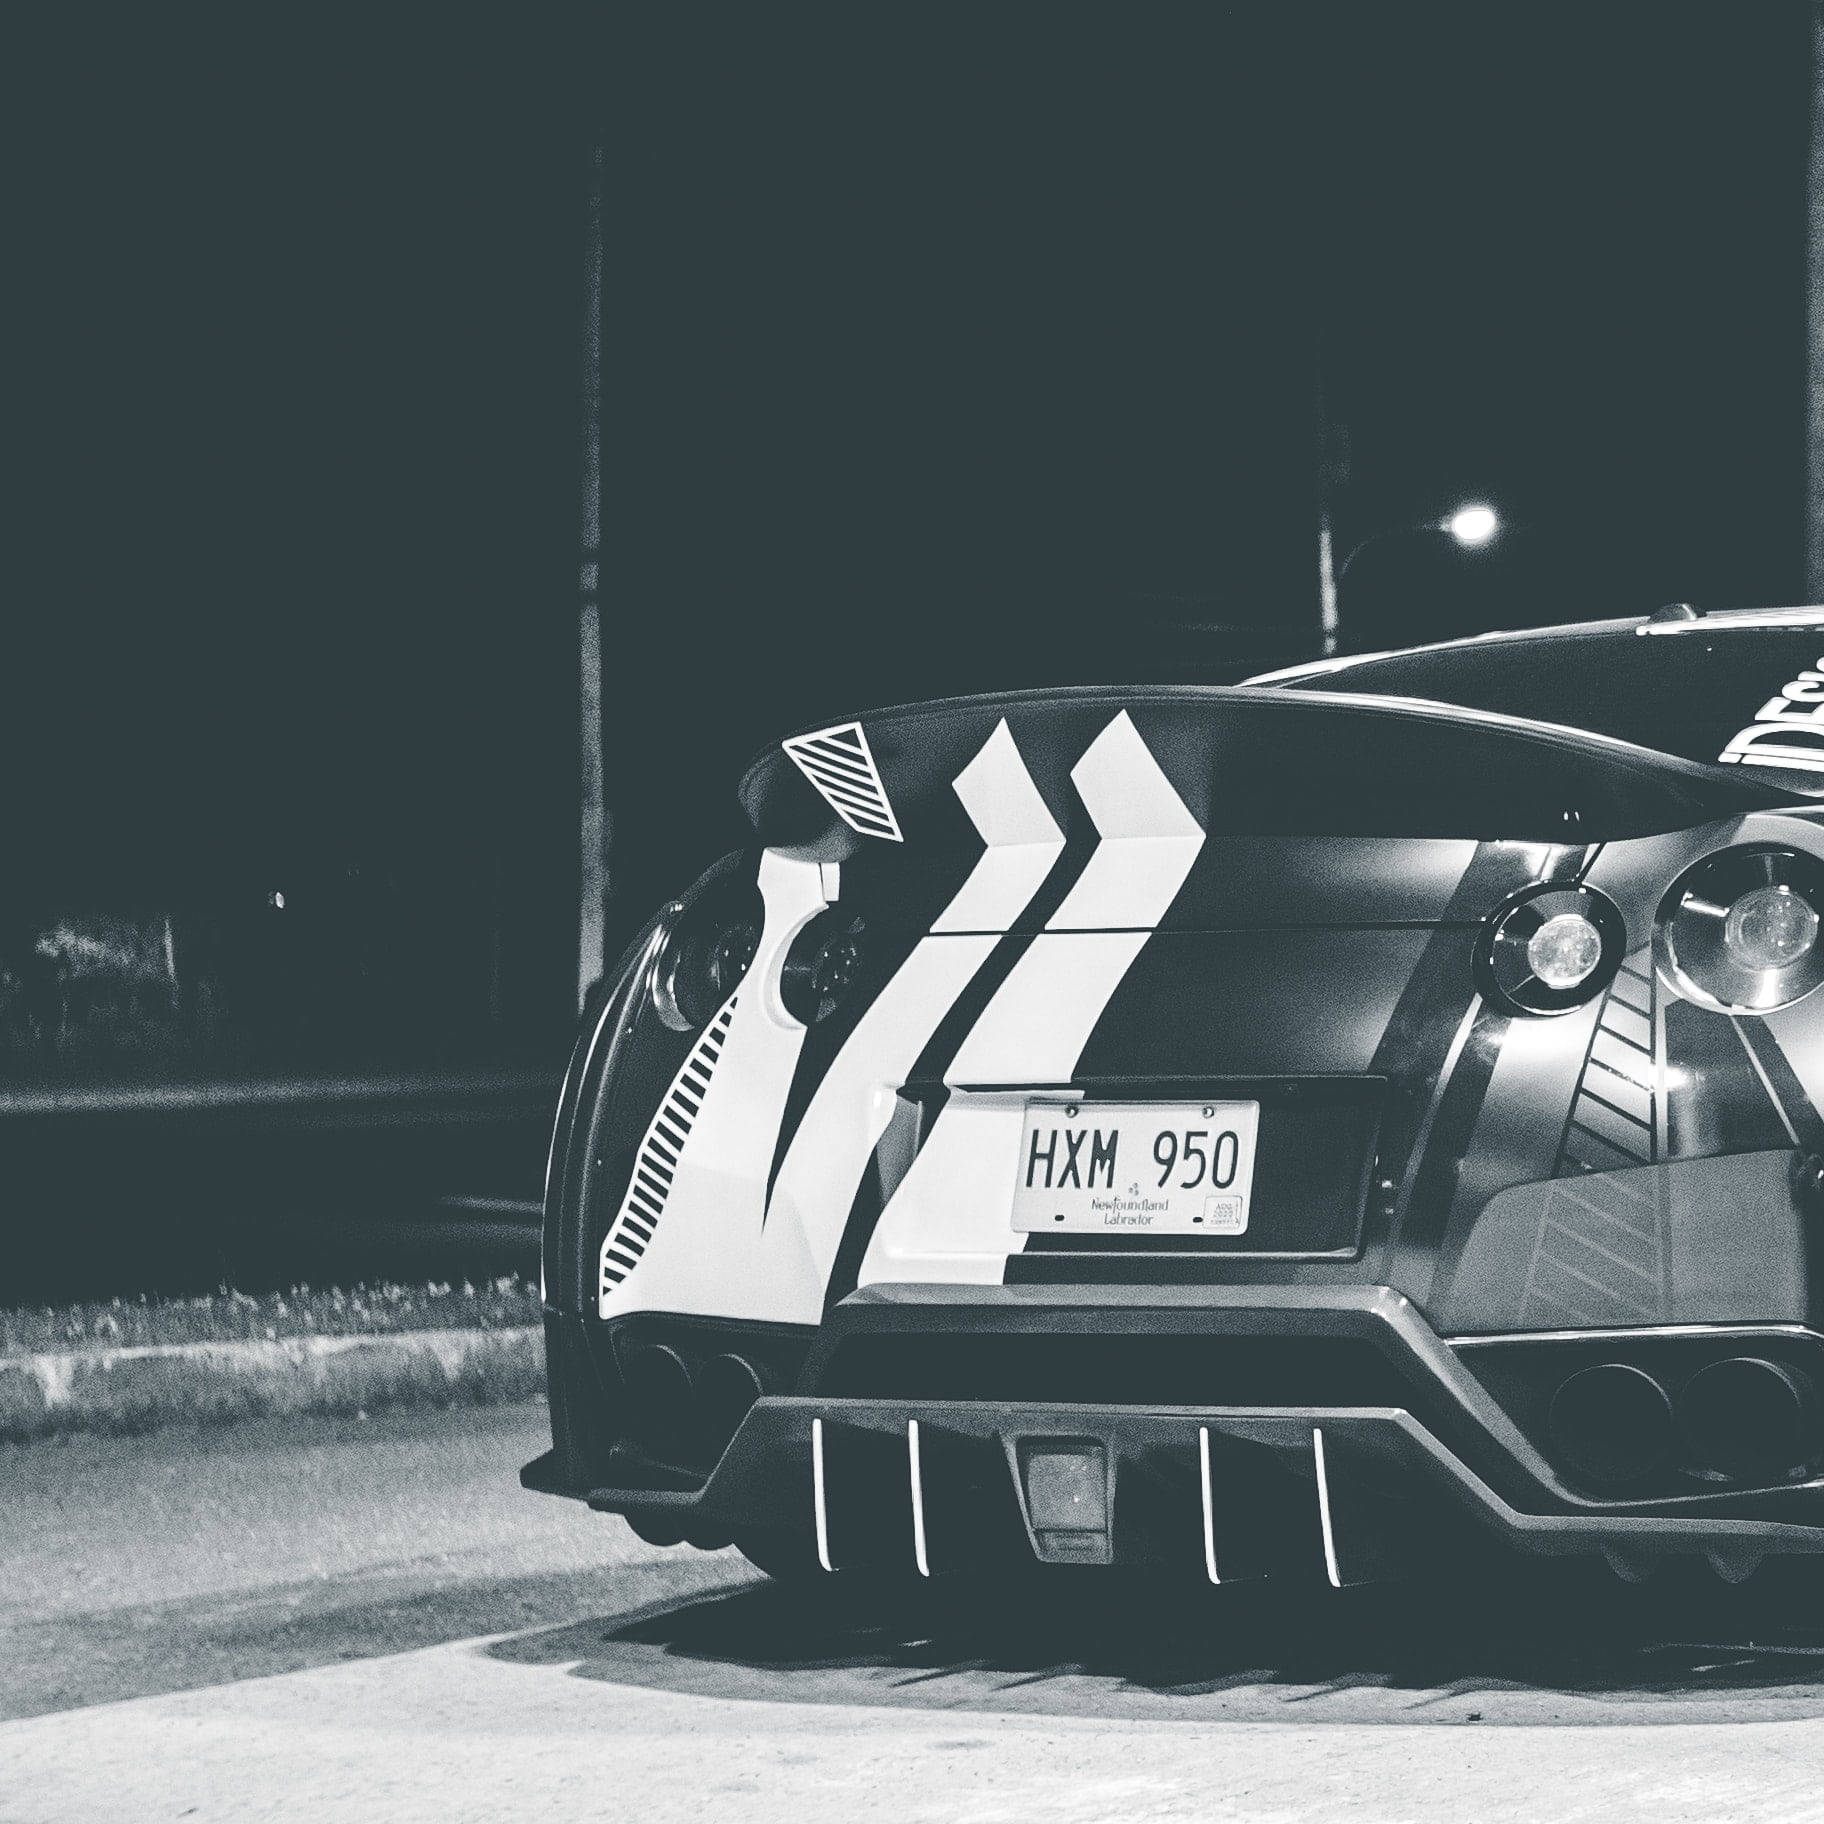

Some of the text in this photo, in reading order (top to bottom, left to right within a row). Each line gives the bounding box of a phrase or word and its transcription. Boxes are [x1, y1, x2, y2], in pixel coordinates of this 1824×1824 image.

[1026, 1129, 1239, 1189] HXM 950
[1091, 1196, 1170, 1214] Newfoundland
[1104, 1212, 1154, 1225] Labrador
